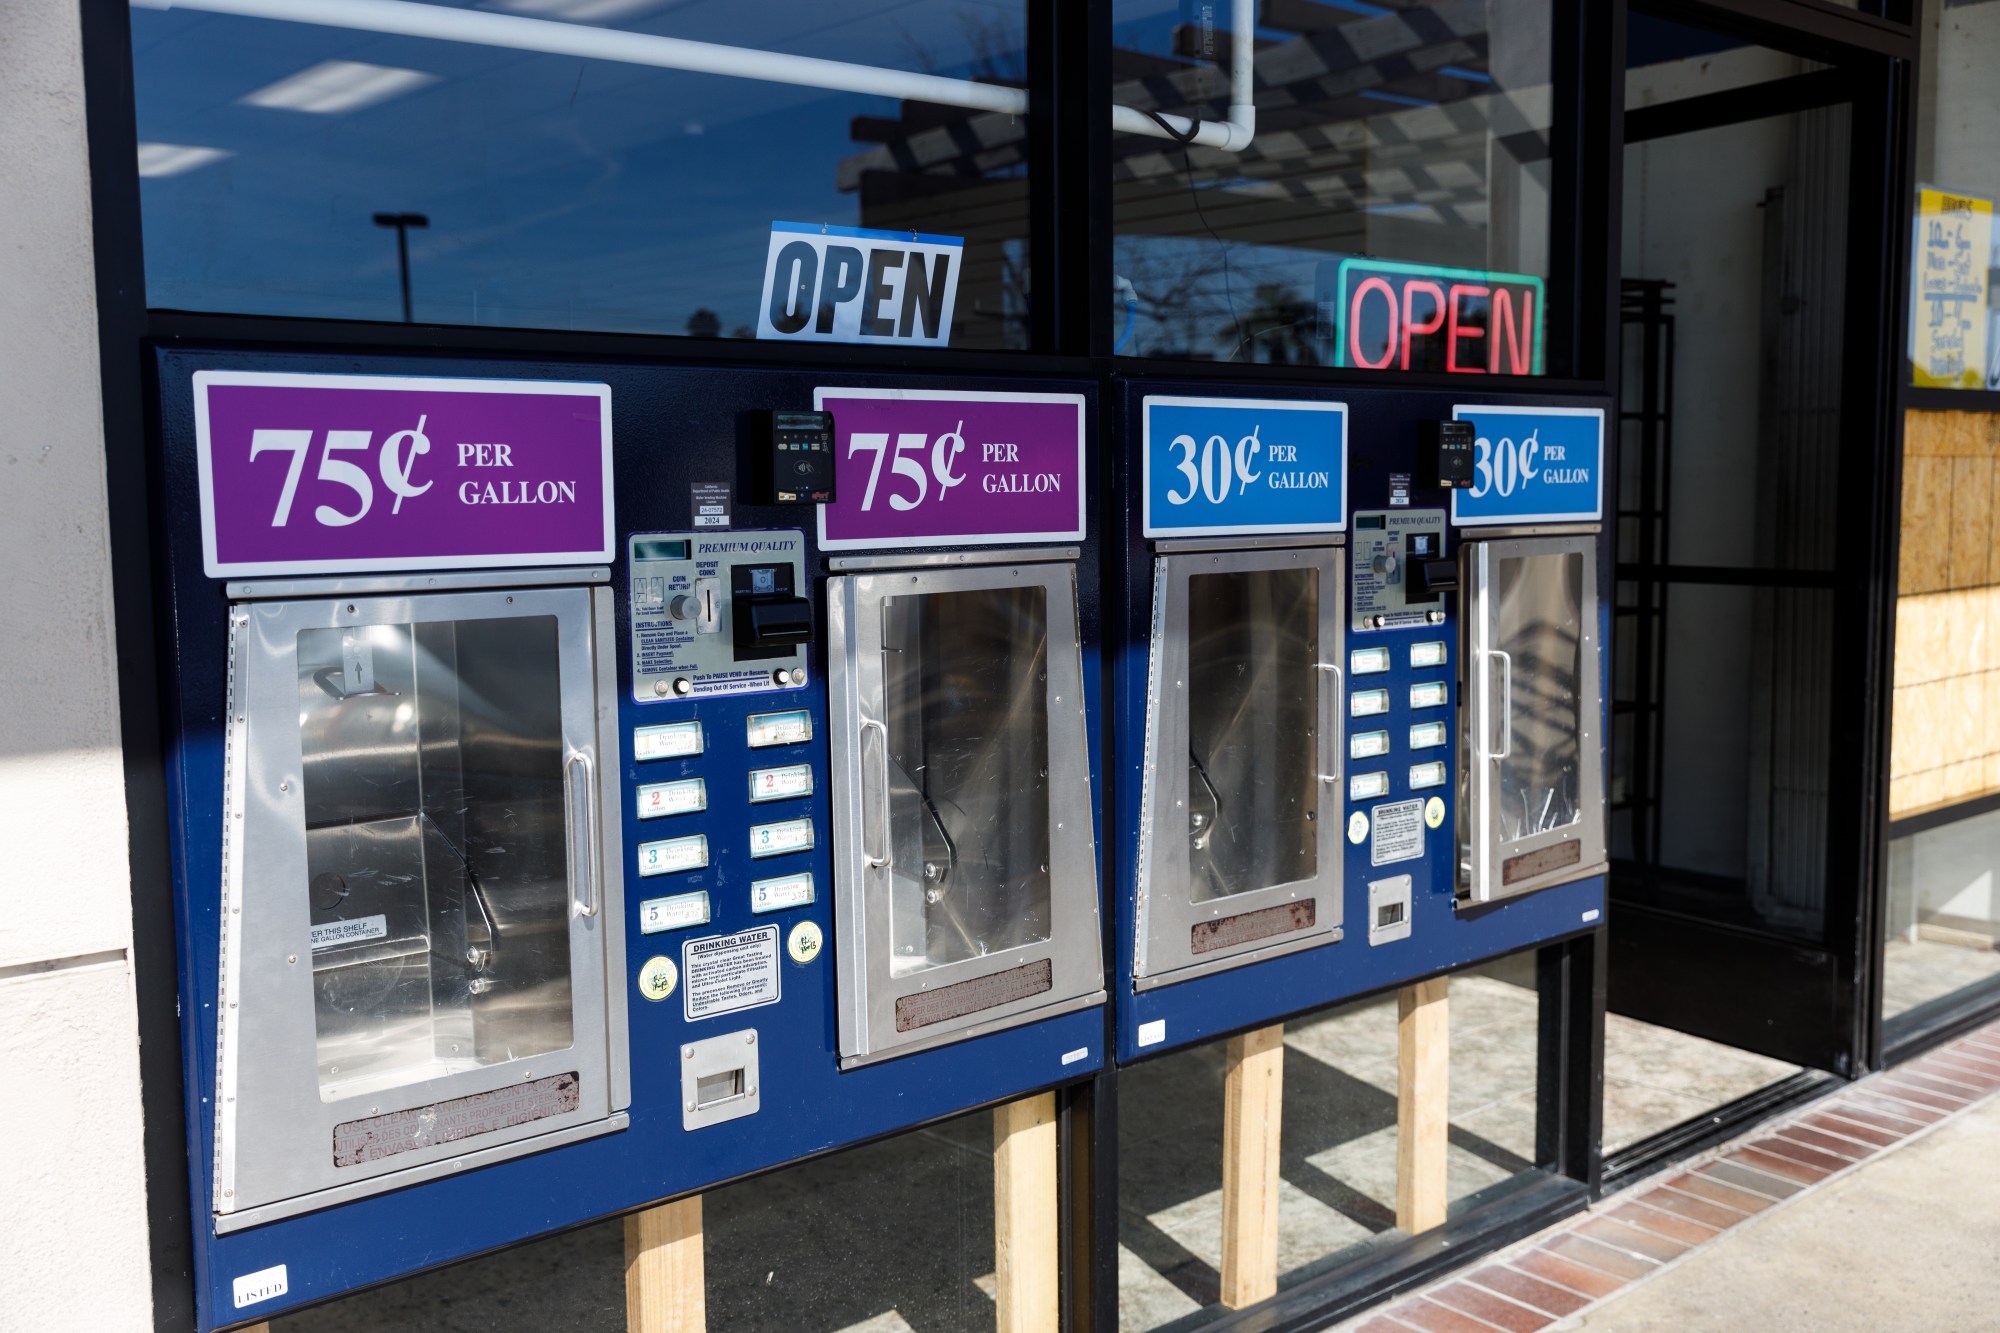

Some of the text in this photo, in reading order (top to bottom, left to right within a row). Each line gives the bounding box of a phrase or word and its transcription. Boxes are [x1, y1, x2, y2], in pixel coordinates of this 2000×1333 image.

[770, 240, 950, 339] OPEN
[1350, 277, 1532, 375] OPEN
[456, 443, 514, 467] PER
[982, 443, 1019, 462] PER
[1268, 445, 1297, 462] PER
[1543, 446, 1566, 461] PER
[248, 415, 434, 527] 75¢
[847, 420, 966, 512] 75¢
[1167, 425, 1261, 505] 30¢
[1468, 428, 1539, 499] 30¢
[982, 474, 1061, 493] GALLON
[1268, 471, 1329, 490] GALLON
[1543, 468, 1589, 485] GALLON
[458, 480, 577, 505] GALLON
[1389, 516, 1442, 526] PREMIUM QUALITY
[698, 540, 797, 553] PREMIUM QUALITY
[696, 561, 719, 569] DEPOSIT
[712, 672, 729, 680] PAUSE
[693, 684, 713, 693] Vending
[659, 732, 687, 741] Drinking
[765, 774, 774, 788] 2
[651, 791, 661, 806] 2
[668, 788, 696, 797] Drinking
[761, 829, 770, 844] 3
[648, 849, 658, 864] 3
[666, 845, 694, 855] Drinking
[758, 887, 767, 902] 5
[774, 883, 799, 892] Drinking
[649, 906, 659, 921] 5
[666, 902, 694, 911] Drinking
[311, 922, 368, 938] ER THIS SHELF
[320, 933, 345, 942] GALLON
[345, 927, 380, 938] CONTAINER
[693, 931, 768, 952] DRINKING WATER
[713, 948, 739, 957] dispensing
[746, 951, 763, 959] Tasting
[691, 966, 716, 974] DRINKING
[703, 969, 725, 977] activated
[720, 970, 746, 979] particulate
[751, 977, 769, 985] Greatly
[719, 988, 741, 997] following
[918, 1010, 958, 1025] ENVASES
[336, 1132, 380, 1152] UTILISER
[381, 1128, 401, 1142] DES
[403, 1113, 468, 1135] COENANTS
[469, 1102, 512, 1121] PROPRES
[514, 1099, 525, 1110] ET
[343, 1119, 369, 1135] USE
[373, 1110, 417, 1128] CLEAN
[339, 1152, 366, 1166] USE
[492, 1119, 500, 1129] E
[506, 1100, 576, 1127] HIGIENICOS
[238, 1283, 282, 1304] LISTED
